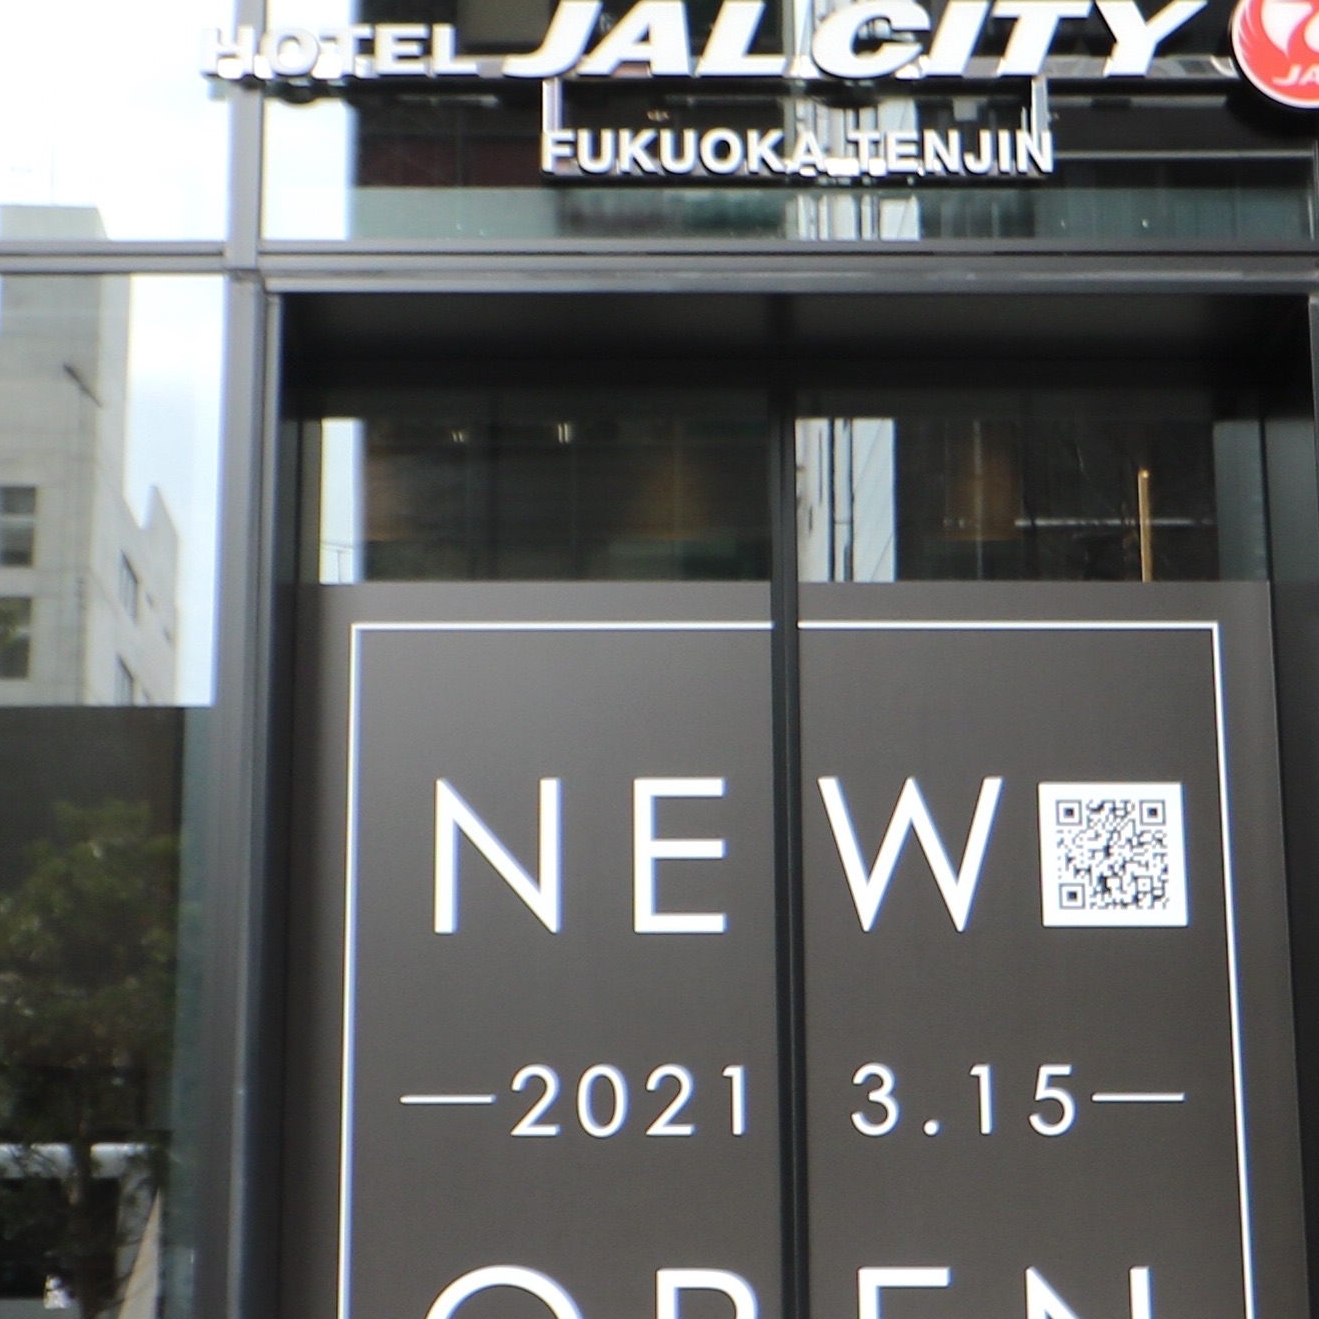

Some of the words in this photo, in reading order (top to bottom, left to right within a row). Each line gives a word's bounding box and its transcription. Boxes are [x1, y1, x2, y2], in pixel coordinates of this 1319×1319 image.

[199, 23, 478, 79] HOTEL
[542, 128, 827, 175] FUKUOKA
[851, 128, 1055, 175] TENJIN
[433, 776, 1004, 934] NEW
[509, 1063, 747, 1138] 2021
[849, 1063, 1078, 1137] 3.15
